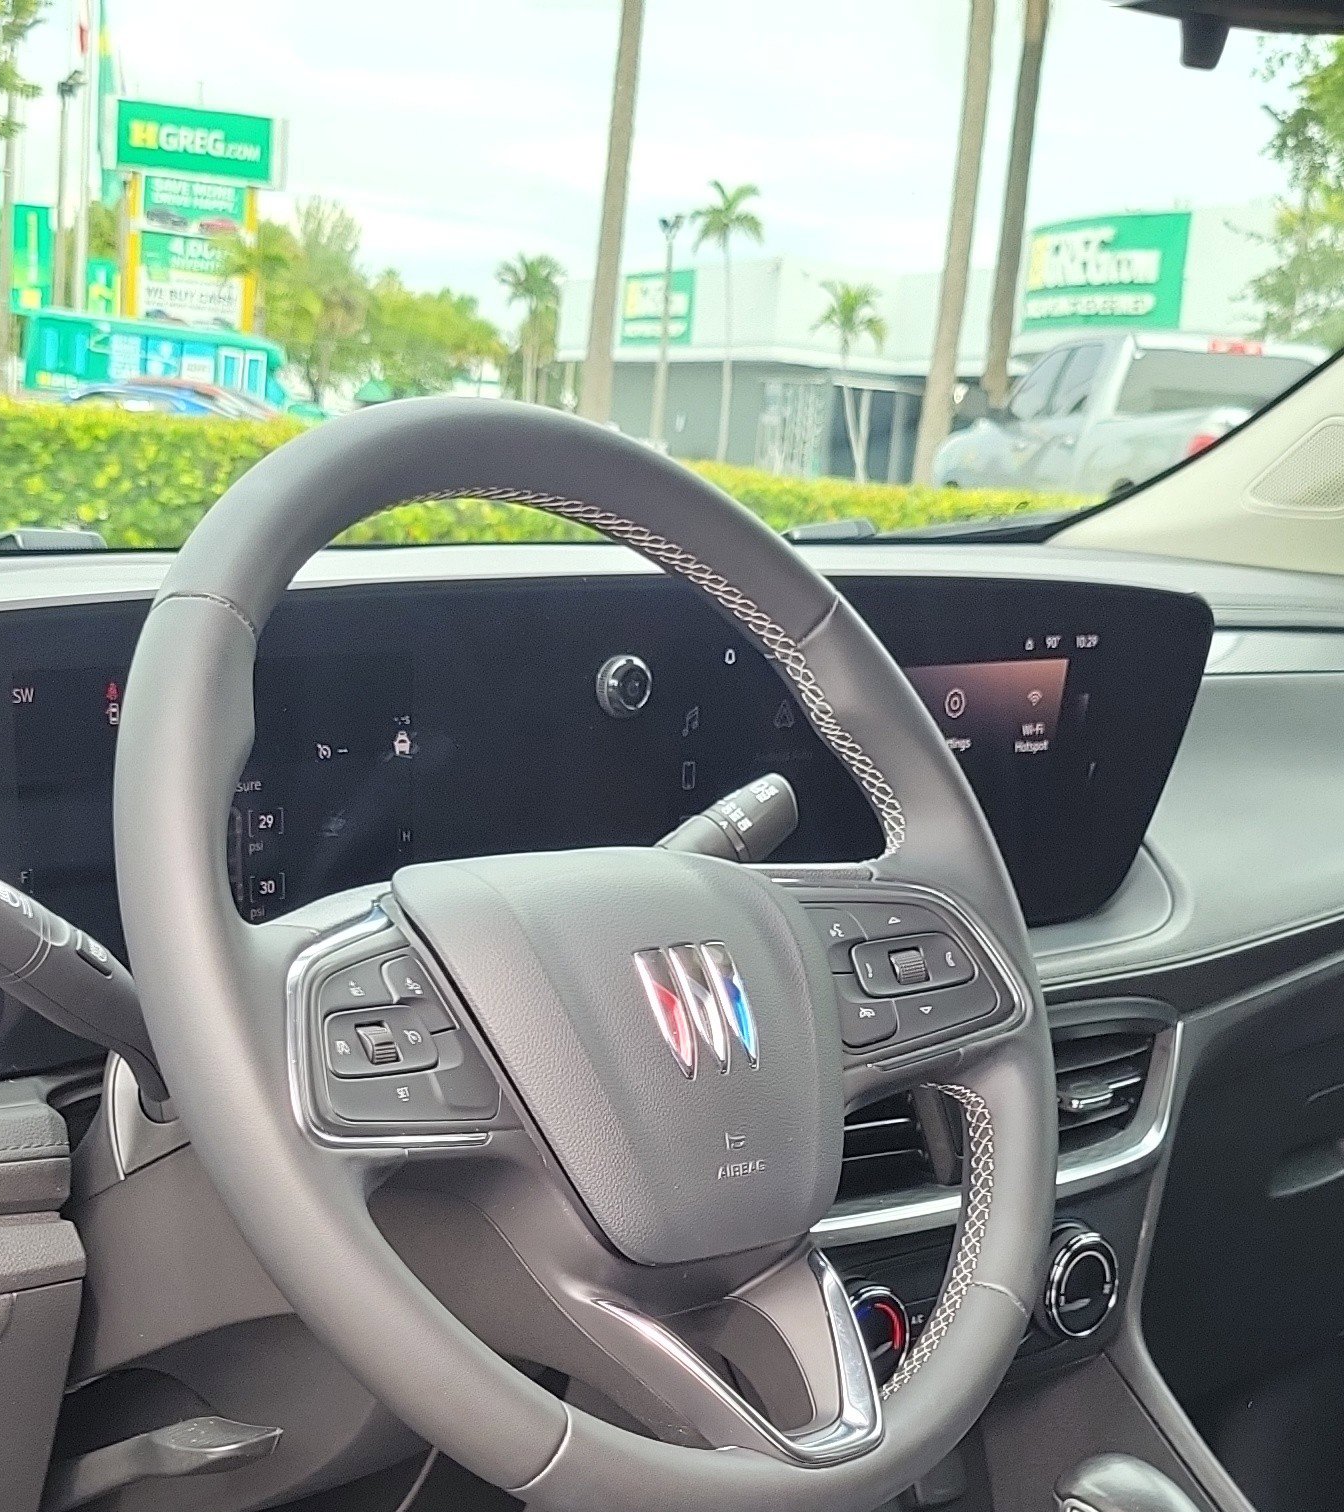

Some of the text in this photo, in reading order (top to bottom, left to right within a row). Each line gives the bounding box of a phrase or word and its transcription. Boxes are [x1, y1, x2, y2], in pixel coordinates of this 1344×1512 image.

[12, 688, 34, 703] SW
[258, 814, 274, 829] 29
[249, 841, 264, 854] psi
[259, 880, 275, 894] 30
[717, 1159, 766, 1179] AIRBAG
